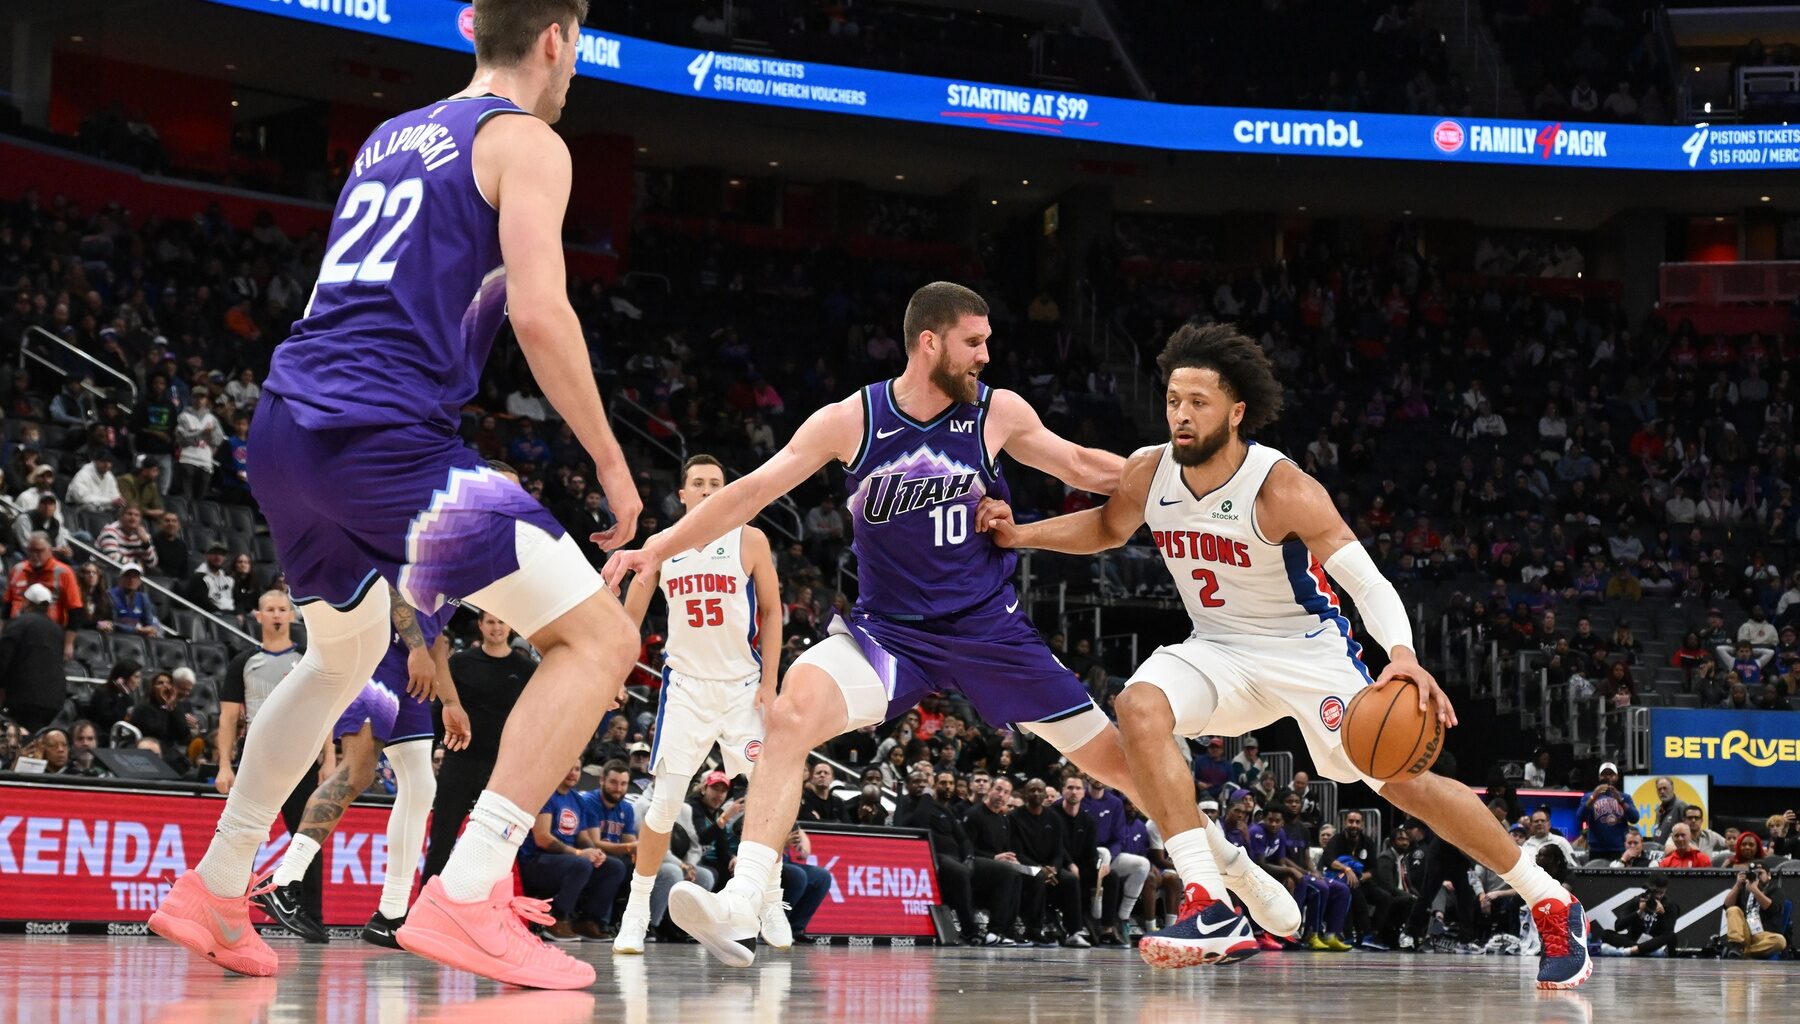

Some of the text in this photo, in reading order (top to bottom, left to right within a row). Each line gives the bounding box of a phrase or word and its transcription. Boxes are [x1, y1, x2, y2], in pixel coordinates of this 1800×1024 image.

[687, 51, 714, 91] 4
[715, 55, 805, 79] PISTONS TICKETS
[714, 74, 735, 91] $15
[736, 77, 765, 94] FOOD
[772, 82, 809, 100] MERCH
[810, 86, 867, 106] VOUCHERS
[947, 84, 1088, 121] STARTING AT $99
[1233, 119, 1363, 148] crumbl
[1470, 125, 1537, 154] FAMILY
[1554, 129, 1607, 157] PACK
[1710, 129, 1800, 144] PISTONS TICKETS
[355, 123, 460, 177] FILIPOWSKI
[1682, 129, 1709, 168] 4
[1710, 149, 1731, 165] $15
[1732, 149, 1760, 163] FOOD
[318, 177, 424, 284] 22
[950, 420, 975, 433] LVT
[863, 471, 979, 524] UTAH
[929, 504, 967, 547] 10
[1212, 511, 1238, 521] StockX
[1153, 530, 1252, 568] PISTONS
[667, 573, 737, 598] PISTONS
[1191, 568, 1225, 608] 2
[686, 598, 724, 627] 55
[1664, 729, 1800, 767] BETRIVE
[847, 865, 933, 898] KENDA
[901, 899, 934, 915] TIRE
[25, 922, 69, 935] StockX
[107, 923, 149, 935] StockX
[327, 929, 364, 939] StockX
[848, 936, 874, 946] StockX
[890, 937, 915, 947] StockX
